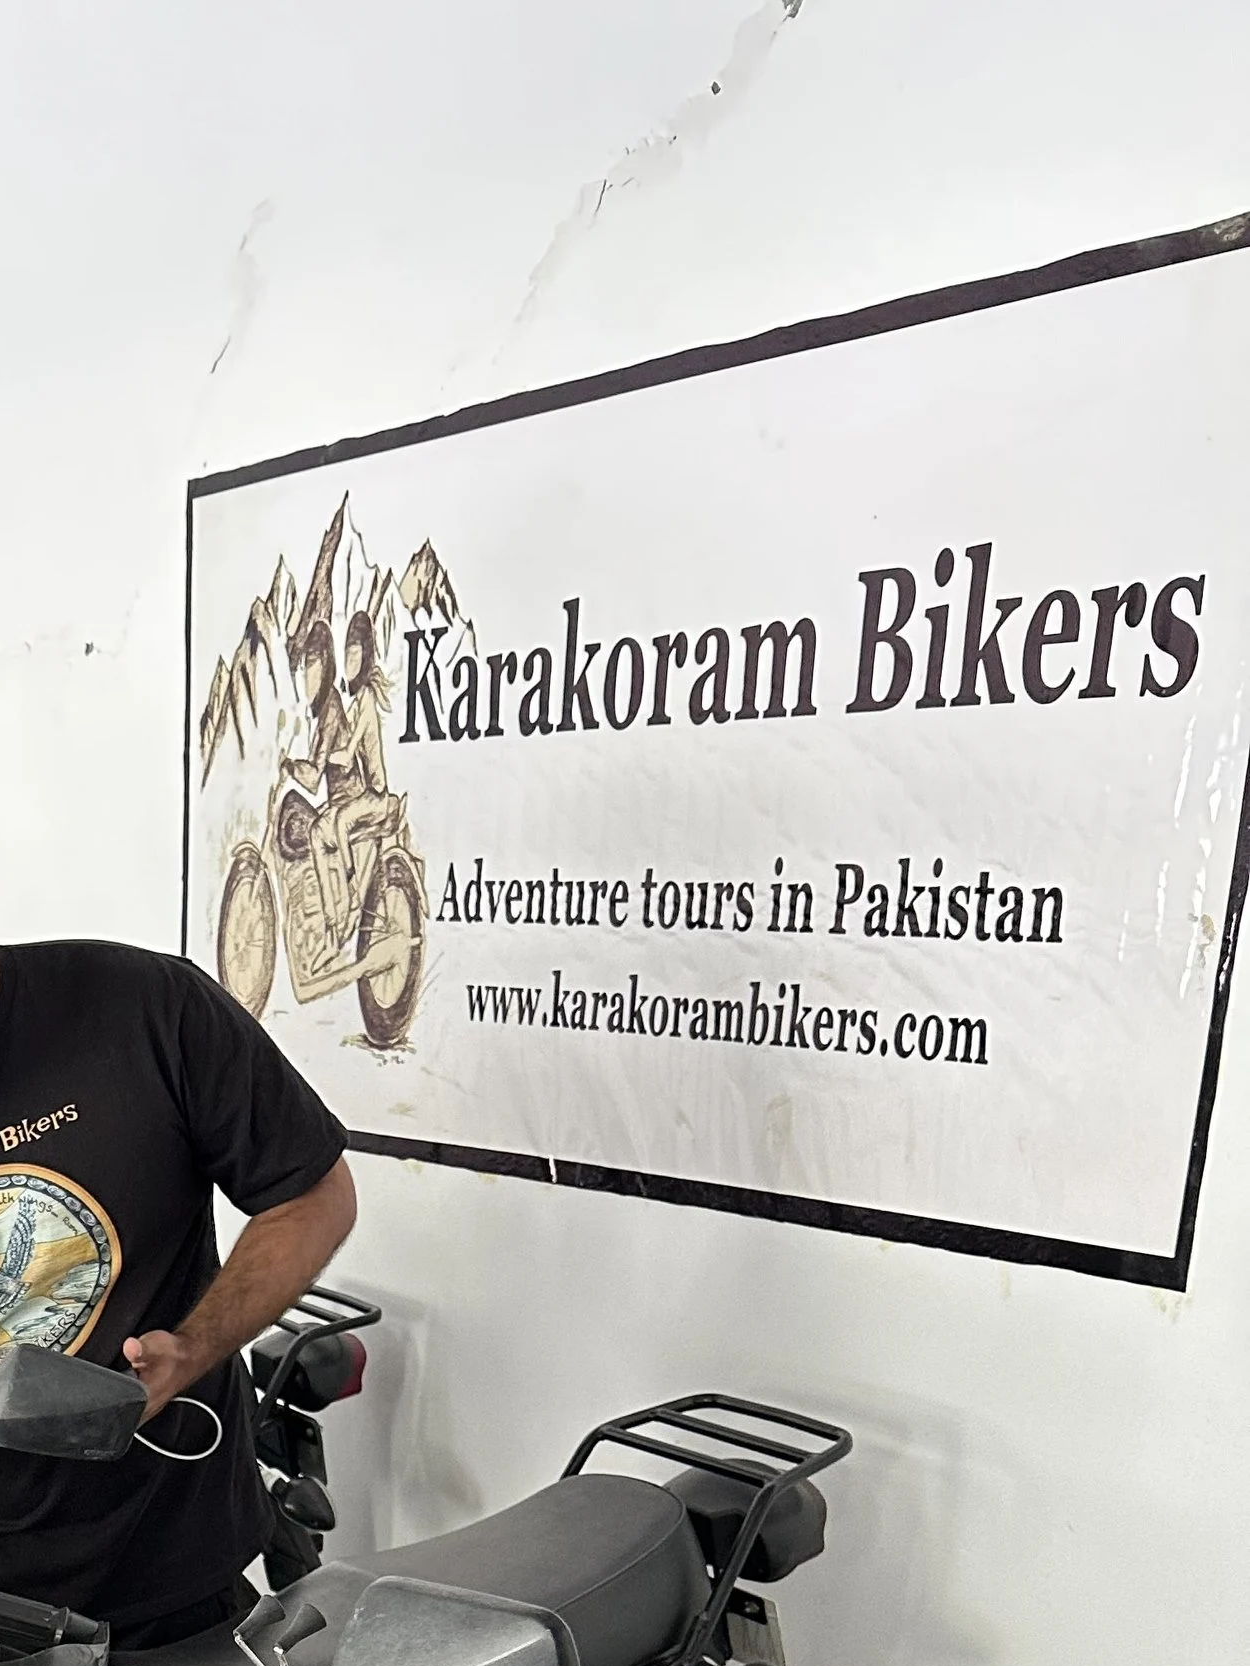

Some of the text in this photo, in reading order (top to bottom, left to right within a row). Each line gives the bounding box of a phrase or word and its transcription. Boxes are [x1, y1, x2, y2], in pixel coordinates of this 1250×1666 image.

[399, 542, 1205, 743] Karakoram Bikers
[436, 858, 1063, 943] Adventure tours in Pakistan
[466, 972, 988, 1065] www.karakorambikers.com
